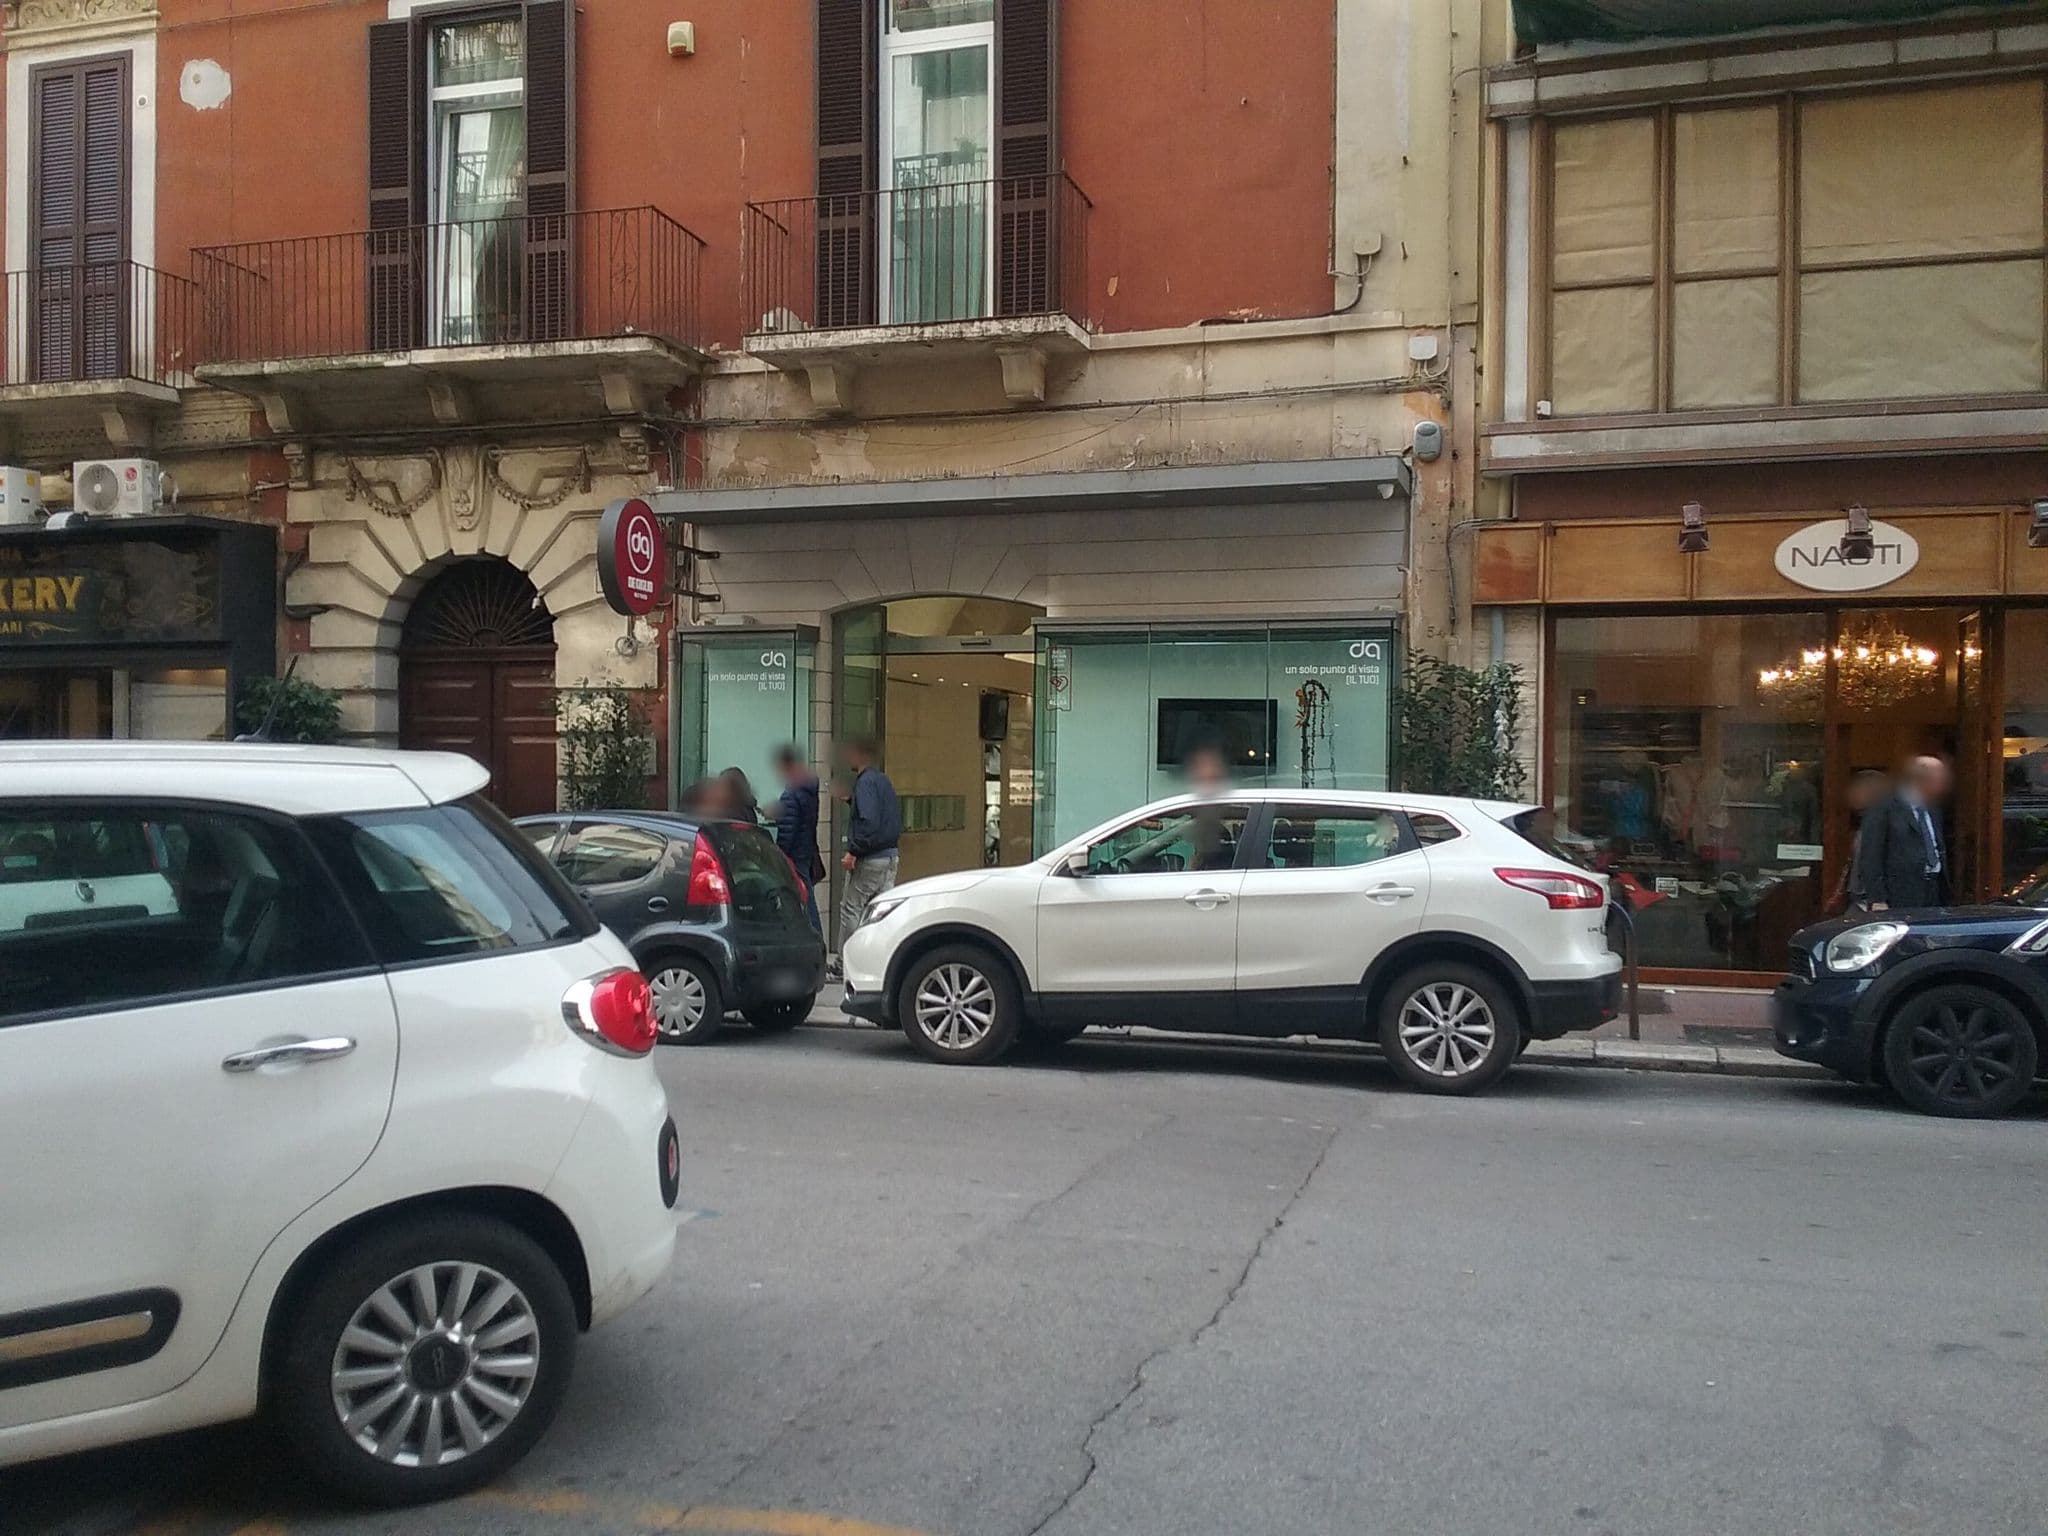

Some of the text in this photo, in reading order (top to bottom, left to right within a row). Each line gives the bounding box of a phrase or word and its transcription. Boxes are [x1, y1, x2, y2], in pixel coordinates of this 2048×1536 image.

[1285, 664, 1380, 676] un solo punto di vista
[709, 672, 785, 683] un solo punto di vista
